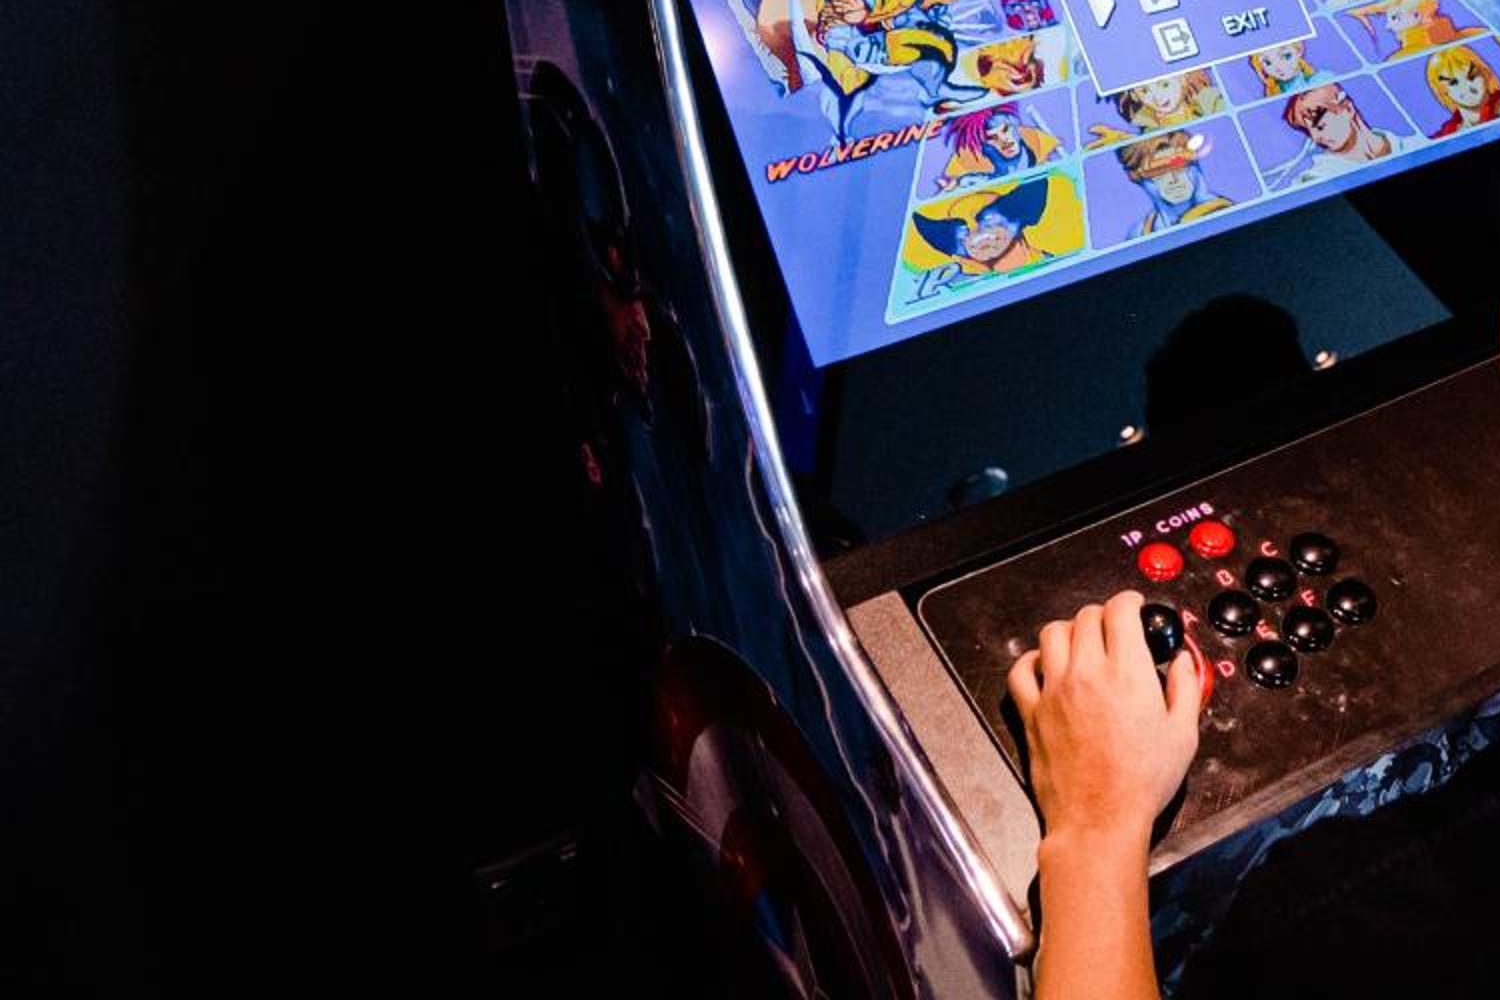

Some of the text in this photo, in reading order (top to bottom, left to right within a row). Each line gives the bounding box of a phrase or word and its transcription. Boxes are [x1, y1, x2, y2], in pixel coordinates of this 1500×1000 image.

[1221, 7, 1270, 36] EXIT
[766, 119, 944, 184] WOLVERINE
[1121, 502, 1214, 548] 1P COINS
[1261, 541, 1279, 557] C
[1216, 569, 1235, 586] B
[1182, 609, 1199, 629] A
[1217, 660, 1236, 678] D
